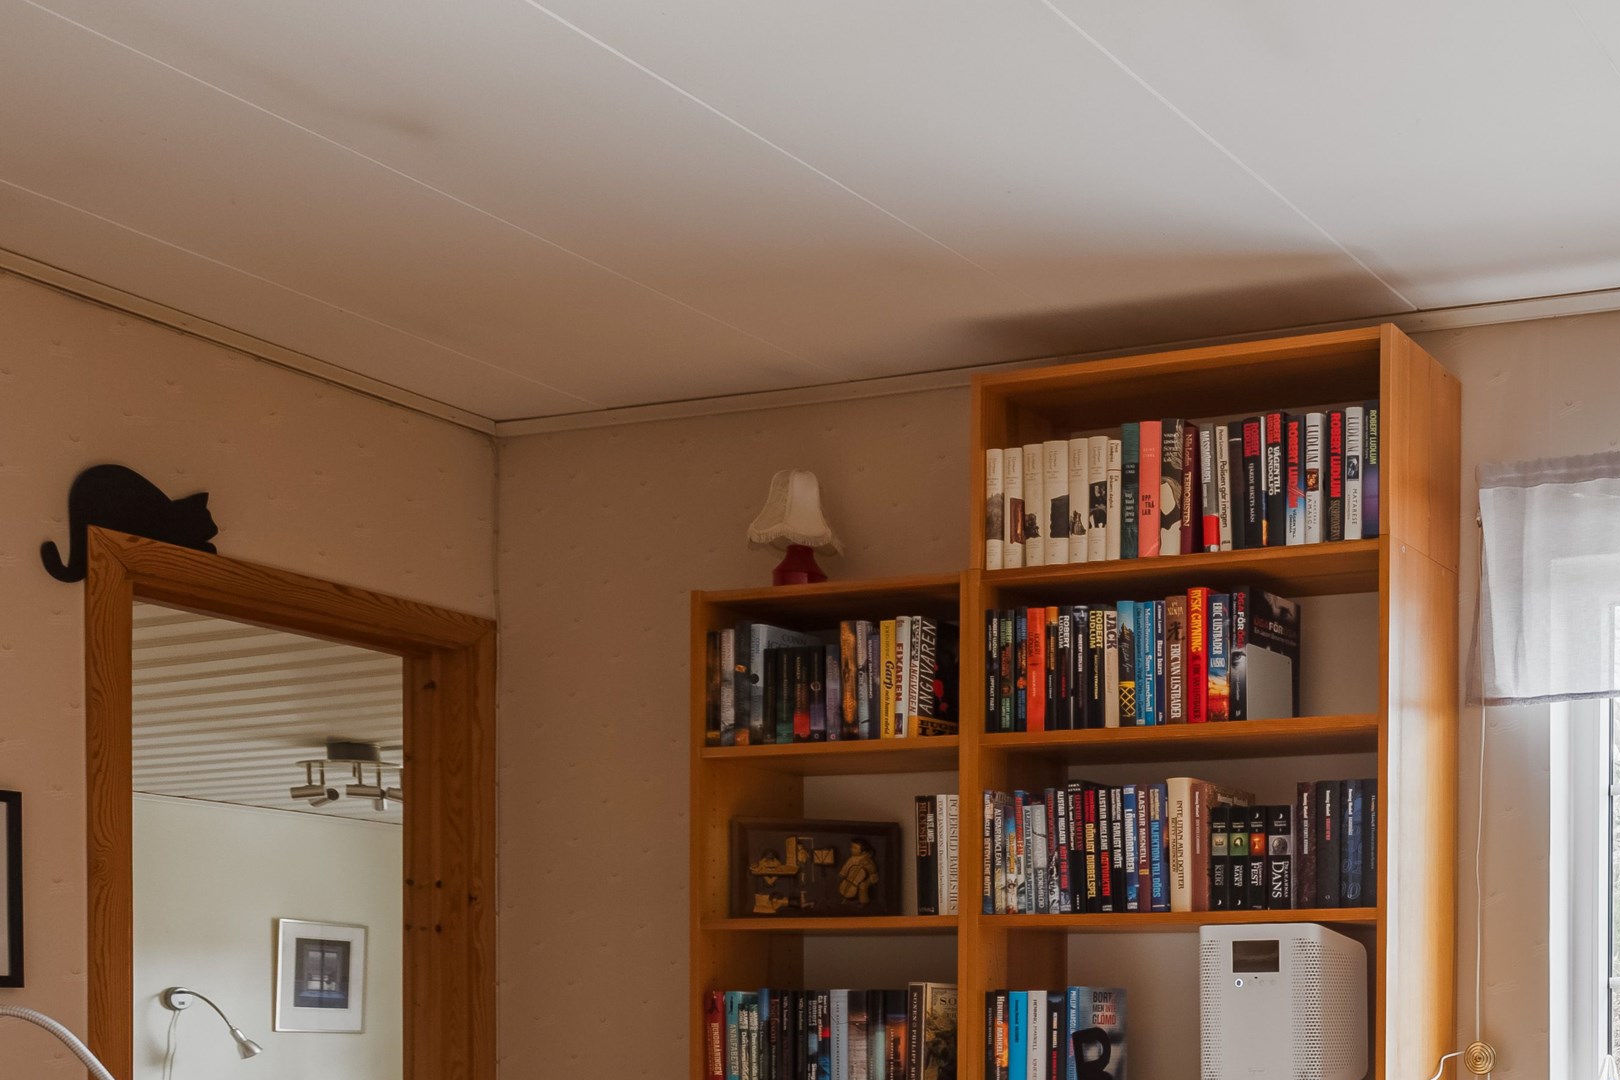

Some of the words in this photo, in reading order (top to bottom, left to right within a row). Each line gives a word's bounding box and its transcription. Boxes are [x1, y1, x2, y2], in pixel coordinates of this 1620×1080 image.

[1330, 413, 1341, 454] ROBERT
[1347, 417, 1360, 453] LUDLUM
[1369, 410, 1377, 435] ROBERT
[1200, 431, 1211, 484] MASSMÖRDAREN
[1288, 421, 1298, 463] ROBERT
[1306, 424, 1319, 463] LUDLUM
[1369, 437, 1377, 465] LUDLUM
[1274, 446, 1282, 475] VÄGEN
[1330, 456, 1341, 498] LUDLUM
[1183, 472, 1192, 526] TERRORISTEN
[1219, 487, 1227, 500] går
[1220, 504, 1229, 528] ringen
[1191, 590, 1202, 610] RYSK
[1213, 603, 1223, 616] ERIC
[1106, 614, 1117, 650] JACK
[1191, 613, 1202, 653] GRYNING
[1212, 619, 1222, 655] LUSTBADER
[1171, 643, 1181, 660] ERIC
[1171, 661, 1181, 675] VAN
[883, 660, 895, 689] Garp
[895, 643, 904, 702] FIXAREN
[908, 663, 918, 714] ANGIVAREN
[1171, 676, 1181, 719] LUSTBADER
[1138, 791, 1146, 826] ALASTAIR
[949, 813, 958, 851] JERSILD
[1125, 809, 1136, 873] LÖNNMÖRDAREN
[1151, 822, 1160, 861] INJEKTION
[994, 835, 1002, 866] MACLEAN
[949, 856, 958, 890] BABELS
[1152, 863, 1160, 876] TILL
[1272, 861, 1284, 898] DANS
[729, 1024, 738, 1075] ANALFABETEN
